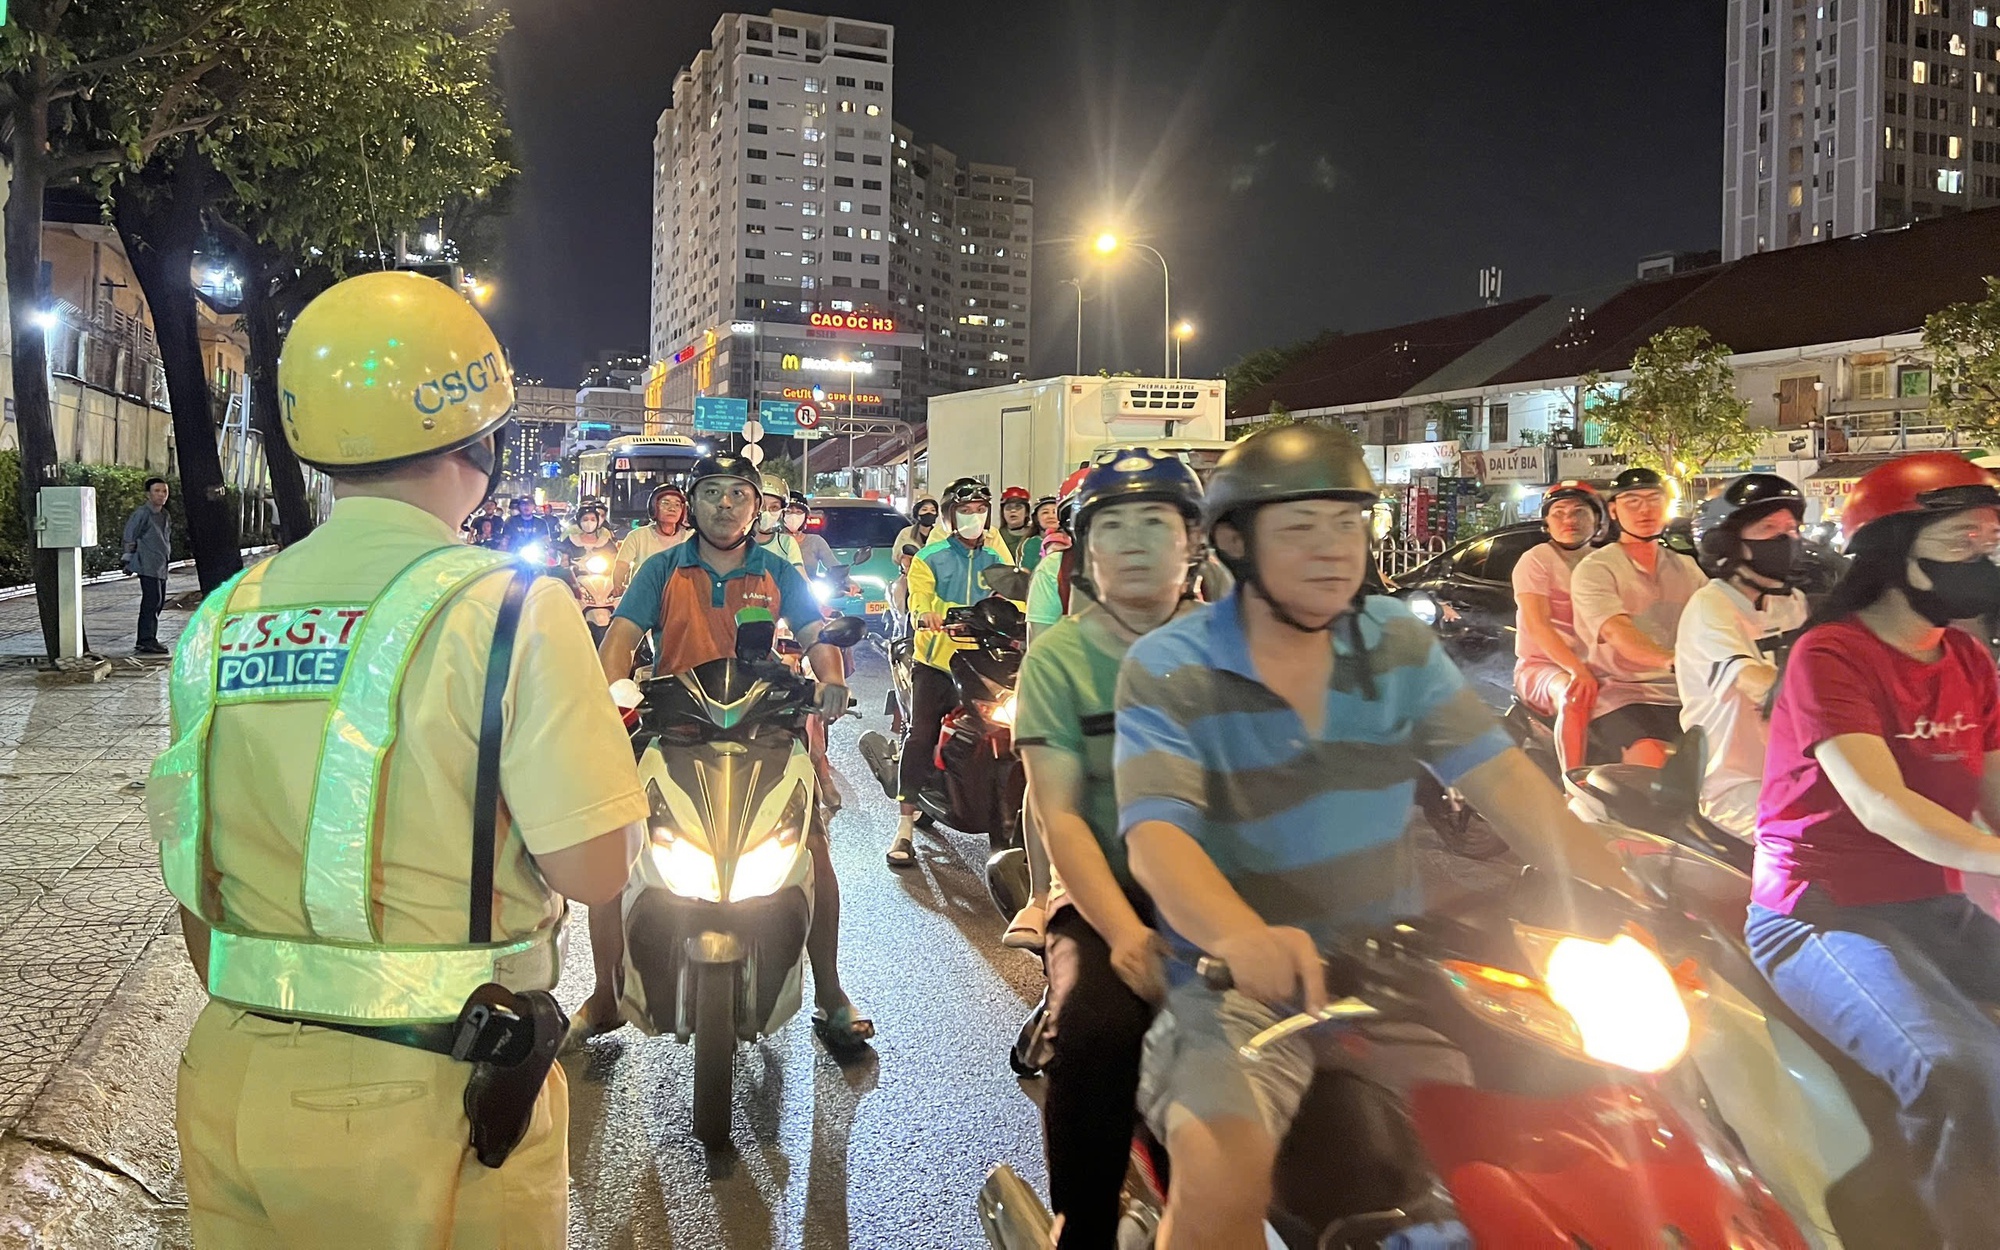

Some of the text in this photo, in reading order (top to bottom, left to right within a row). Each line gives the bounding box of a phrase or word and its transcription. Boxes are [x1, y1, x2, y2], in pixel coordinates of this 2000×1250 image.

[810, 310, 893, 331] CAO ỐC H3
[413, 352, 500, 414] CSGT
[617, 458, 628, 468] 31
[1489, 453, 1538, 475] ĐẠI LÝ BIA
[220, 652, 336, 688] POLICE
